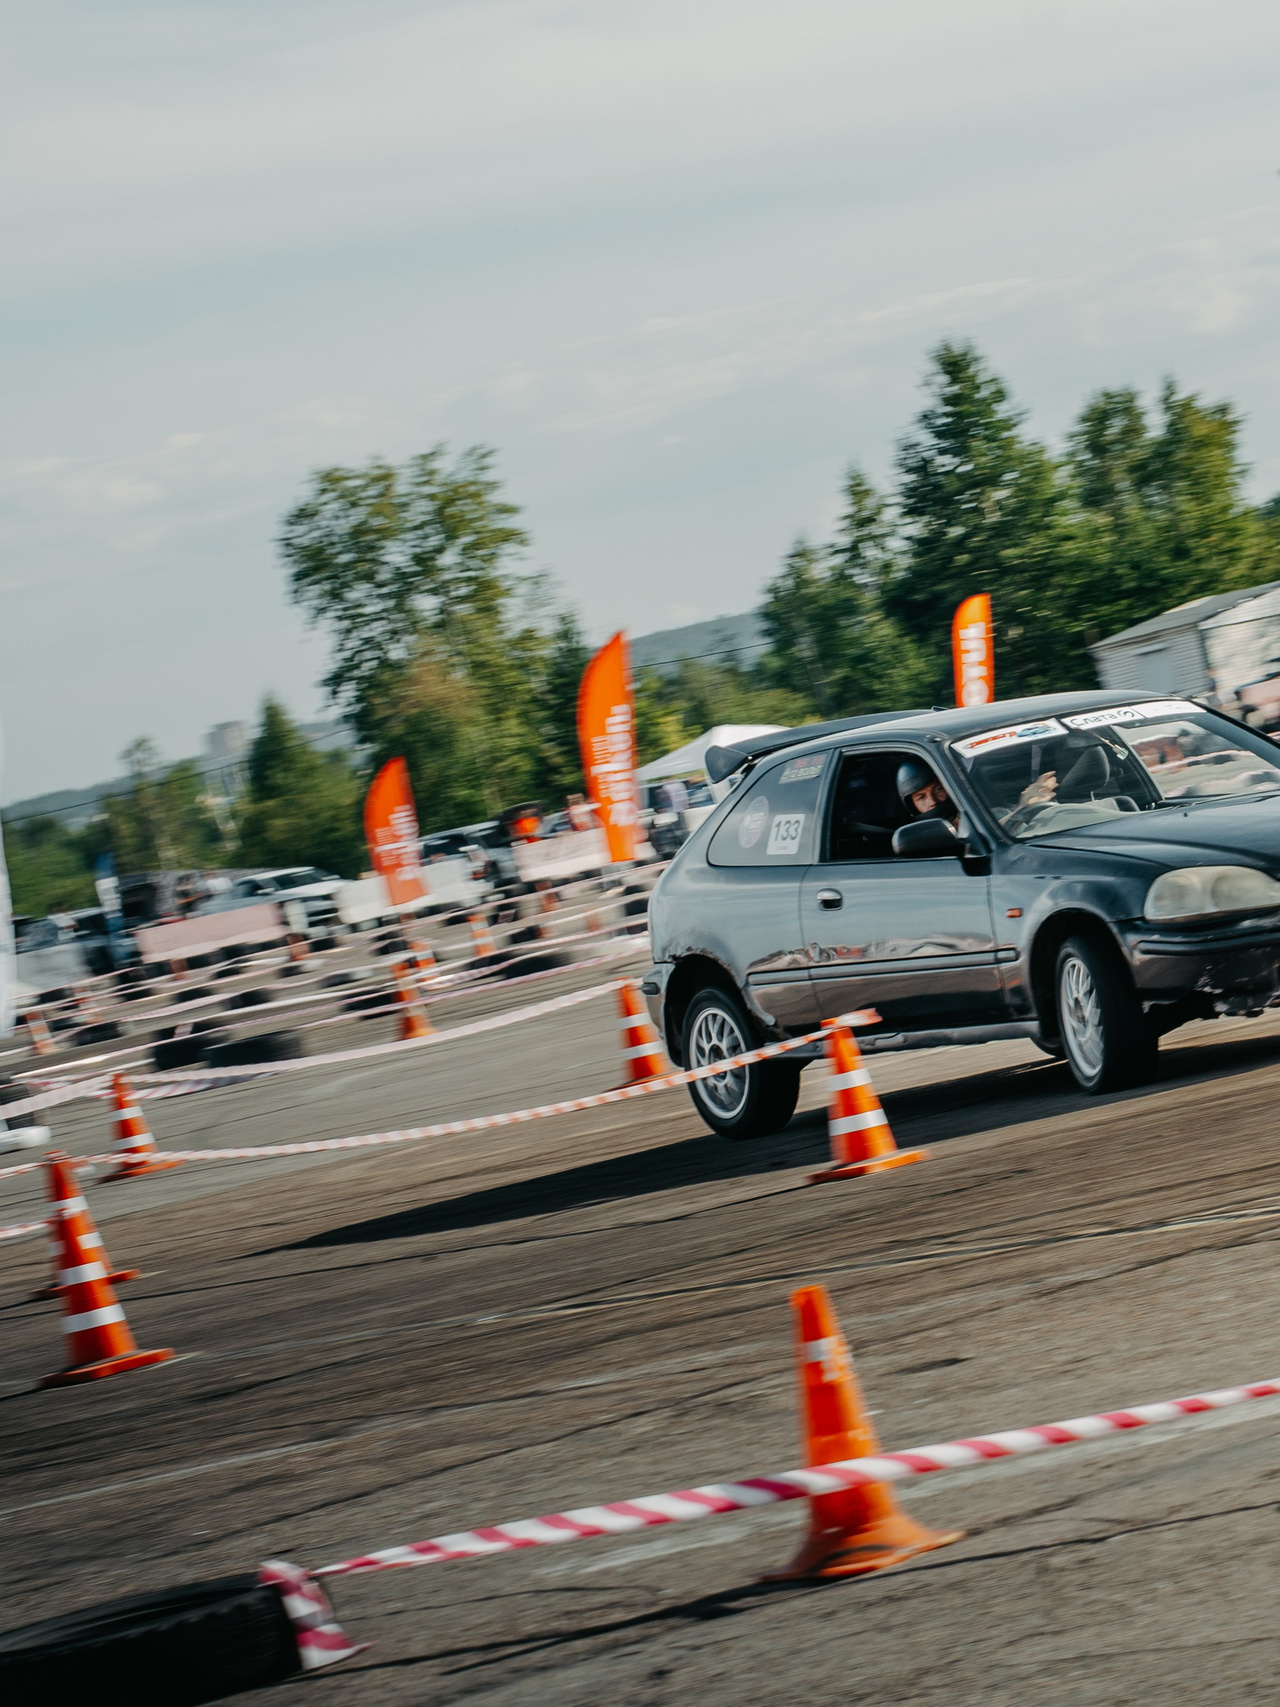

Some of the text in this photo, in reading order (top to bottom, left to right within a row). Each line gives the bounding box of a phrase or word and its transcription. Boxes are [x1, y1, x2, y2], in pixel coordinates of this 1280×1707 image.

[959, 621, 990, 706] OTUL
[1069, 707, 1118, 727] Слата
[774, 819, 801, 842] 133
